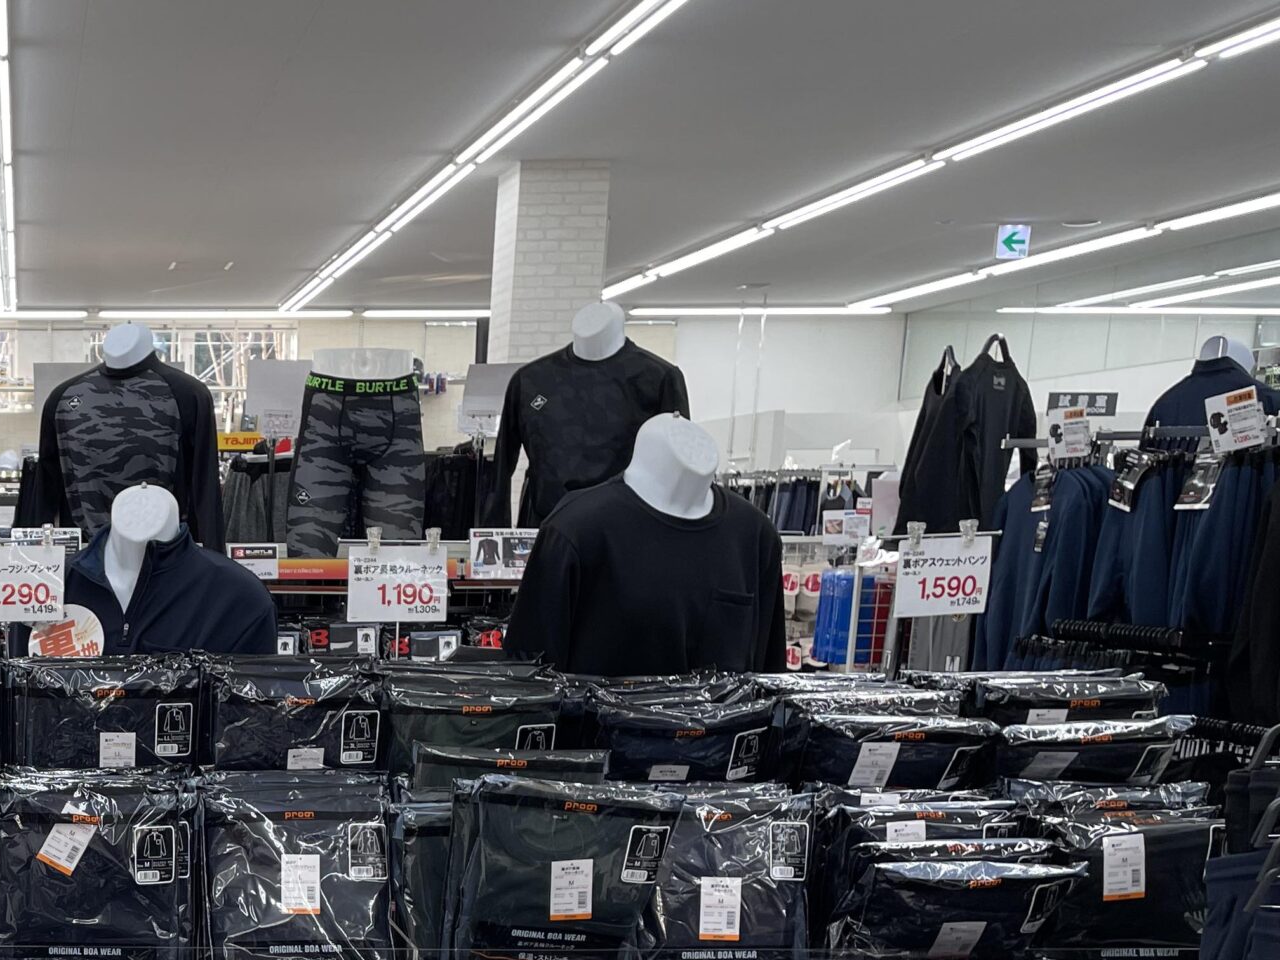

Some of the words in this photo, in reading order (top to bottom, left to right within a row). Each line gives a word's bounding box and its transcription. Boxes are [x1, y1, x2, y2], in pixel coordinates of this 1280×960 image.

[355, 379, 410, 394] BURTLE
[511, 929, 546, 939] ORIGINAL
[564, 934, 586, 942] WEAR
[48, 947, 82, 955] ORIGINAL
[83, 947, 98, 955] BOA
[99, 947, 122, 956] WEAR
[269, 945, 303, 953] ORIGINAL
[304, 945, 320, 953] BOA
[321, 944, 343, 953] WEAR
[681, 951, 716, 959] ORIGINAL
[717, 951, 733, 959] BOA
[735, 950, 757, 959] WEAR
